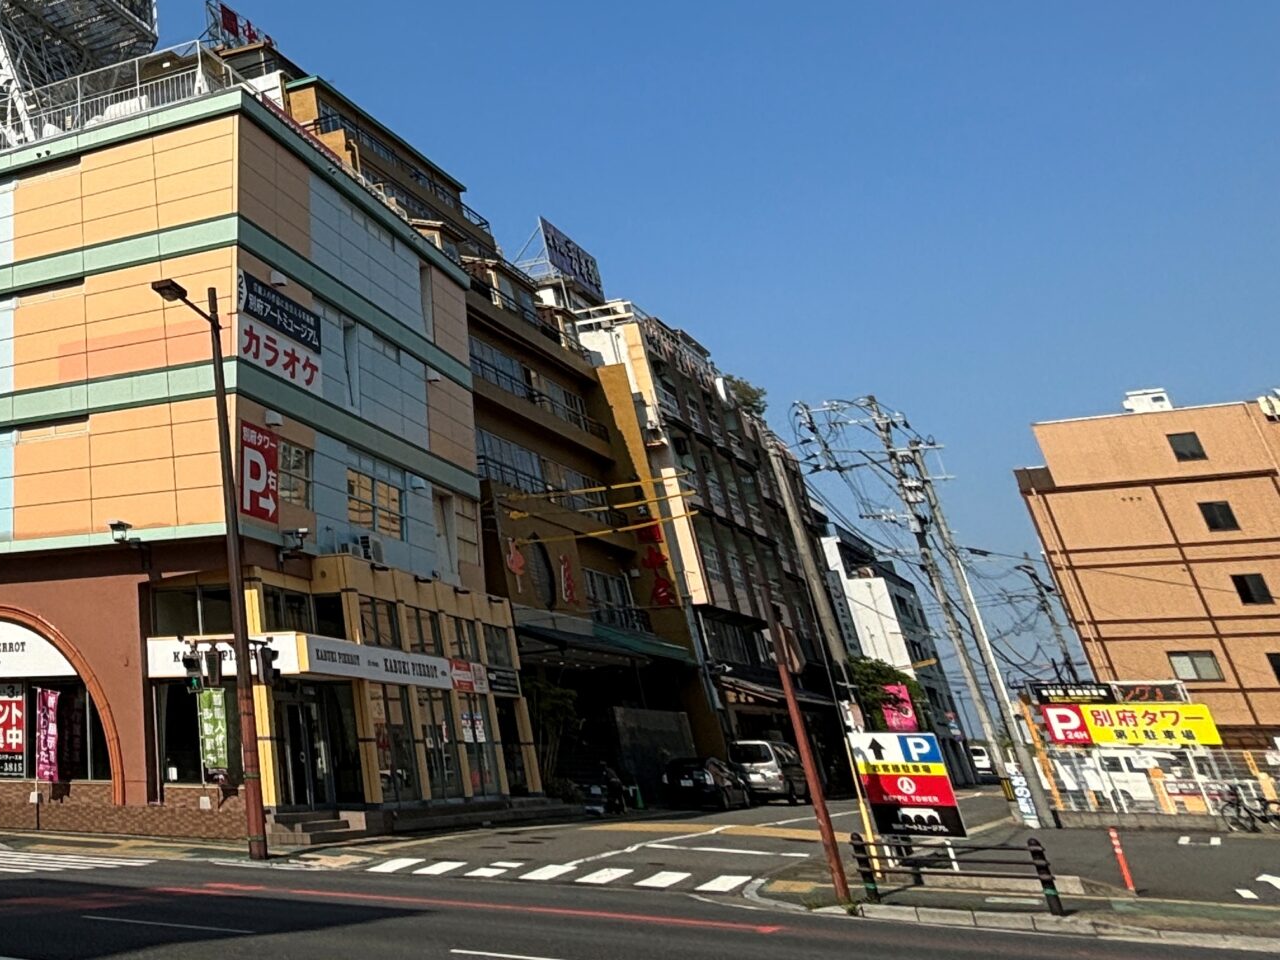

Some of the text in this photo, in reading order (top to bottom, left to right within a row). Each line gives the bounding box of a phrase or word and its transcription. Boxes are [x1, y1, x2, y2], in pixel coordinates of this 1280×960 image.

[248, 293, 320, 347] 別府アートミュージアム
[242, 324, 319, 387] カラオケ
[242, 426, 277, 449] 別府タワー
[243, 445, 267, 512] P
[267, 469, 277, 492] 右
[383, 657, 410, 676] KABUKI
[1045, 707, 1089, 740] P 24H
[1090, 709, 1204, 728] 別府タワー
[1113, 728, 1196, 741] 第1駐車場
[906, 737, 931, 761] P
[911, 795, 939, 803] TOWER
